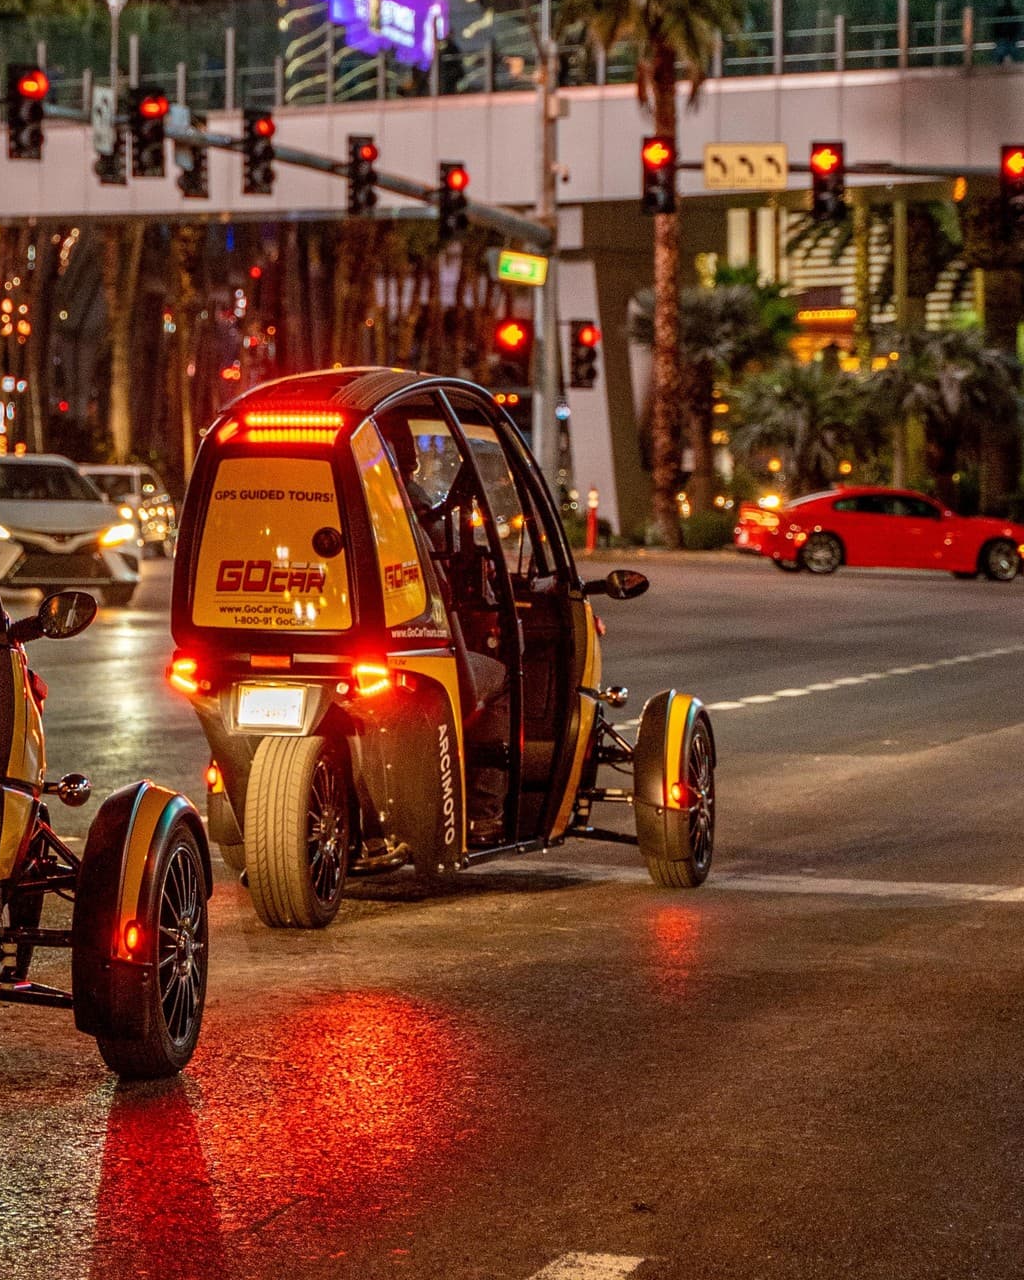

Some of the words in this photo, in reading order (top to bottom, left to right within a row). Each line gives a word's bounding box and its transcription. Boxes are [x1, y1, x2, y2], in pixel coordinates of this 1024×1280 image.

[215, 491, 237, 501] GPS
[240, 490, 285, 500] GUIDED
[289, 491, 334, 503] TOURS!
[219, 605, 320, 616] www.GoCarTour
[438, 724, 455, 845] ARCIMOTO
